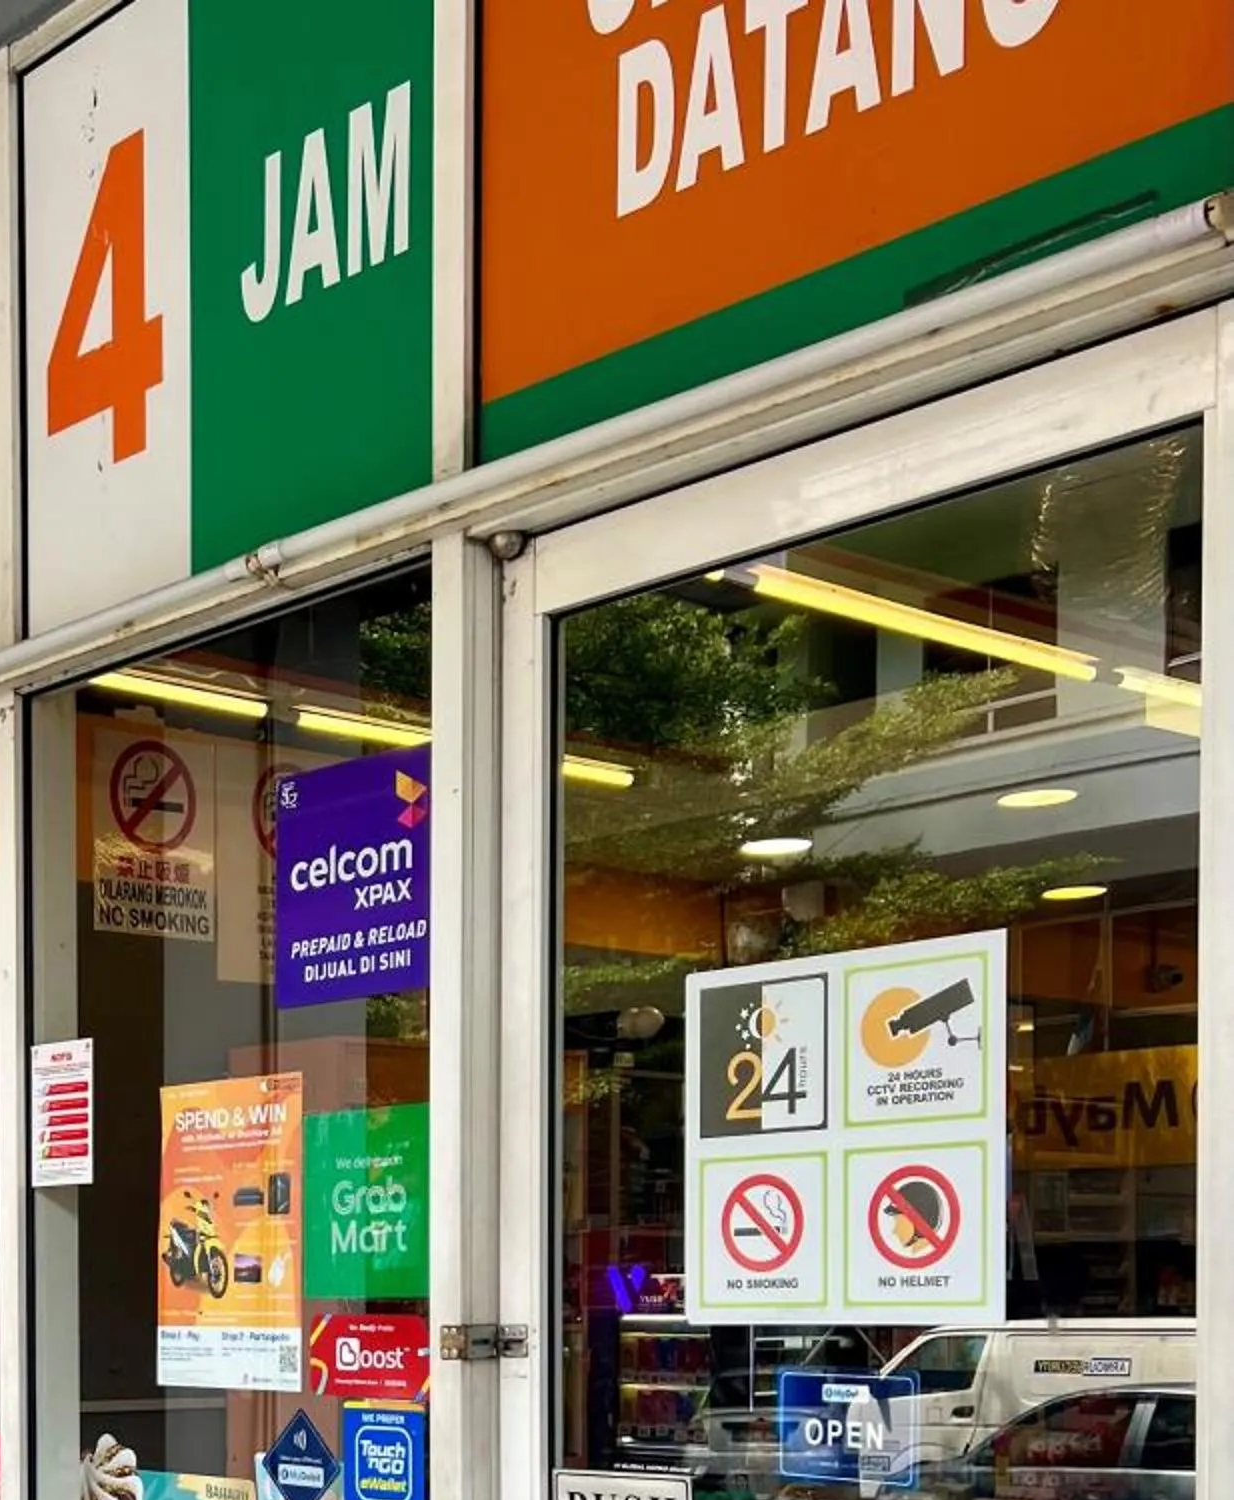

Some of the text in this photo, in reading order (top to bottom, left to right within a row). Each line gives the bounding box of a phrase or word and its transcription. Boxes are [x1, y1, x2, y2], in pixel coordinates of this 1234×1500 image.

[241, 81, 411, 323] JAM
[290, 837, 413, 892] celcom
[100, 878, 208, 910] DILARANG MEROKOK
[354, 877, 413, 910] XPAX
[99, 906, 211, 936] NO SMOKING
[290, 919, 428, 960] PREPAID & RELOAD
[304, 948, 412, 983] DIJUAL DI SINI
[726, 1047, 807, 1121] 24
[867, 1077, 965, 1097] CCTV RECORDING
[887, 1067, 943, 1083] 24 HOURS
[875, 1090, 955, 1107] IN OPERATION
[174, 1102, 287, 1133] SPEND & WIN
[331, 1174, 407, 1216] Grab
[331, 1219, 408, 1256] Mart
[727, 1277, 799, 1290] NO SMOKING
[877, 1274, 951, 1288] NO HELMET
[336, 1337, 405, 1371] Boost
[359, 1440, 406, 1459] Touch
[804, 1418, 884, 1450] OPEN
